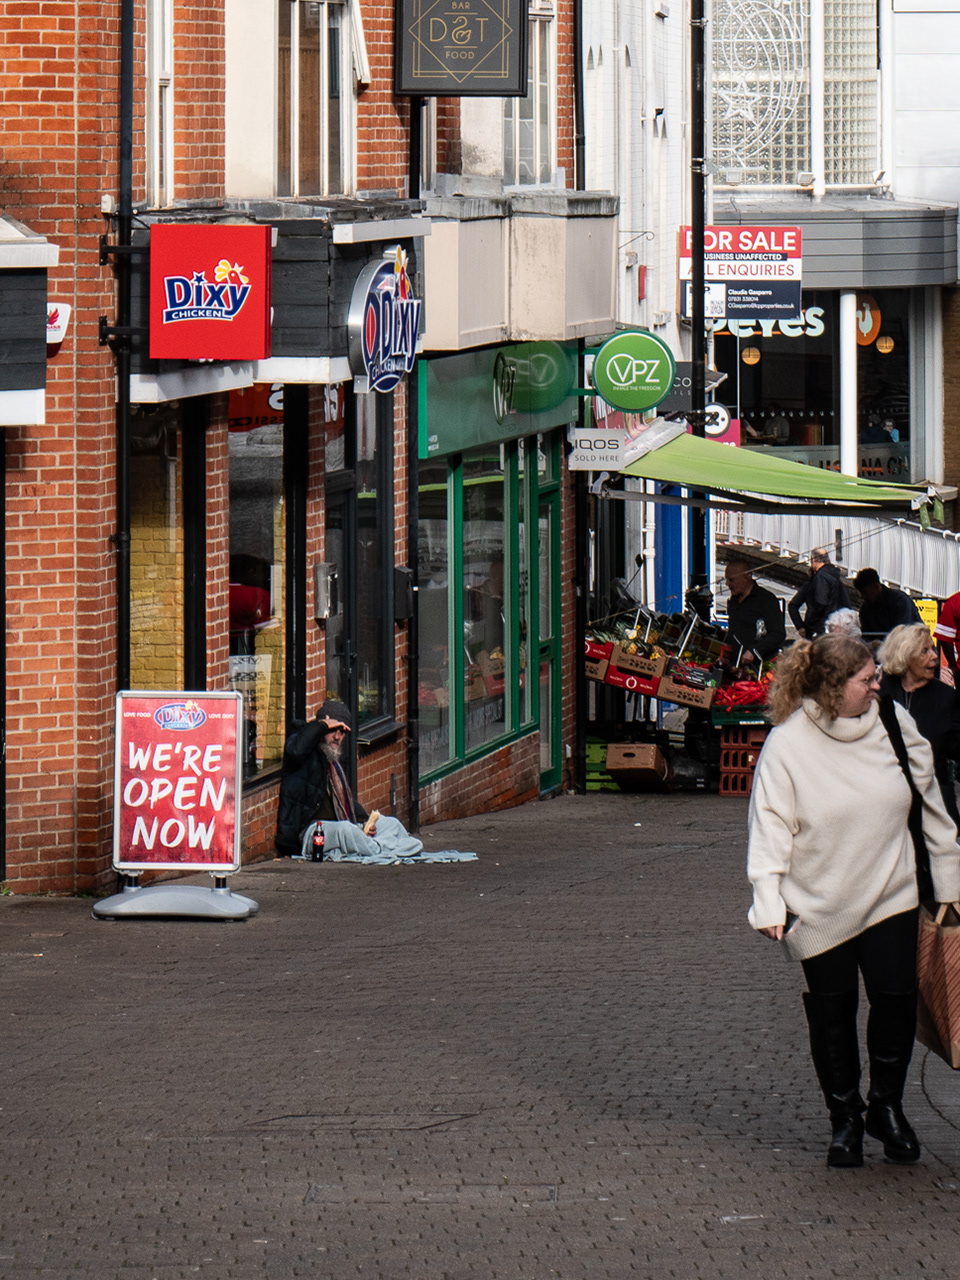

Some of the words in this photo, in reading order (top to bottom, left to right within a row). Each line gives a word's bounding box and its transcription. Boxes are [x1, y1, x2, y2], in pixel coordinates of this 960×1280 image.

[451, 1, 470, 10] BAR
[445, 50, 475, 60] FOOD
[738, 231, 797, 251] SALE
[735, 253, 782, 261] UNAFFECTED
[718, 263, 795, 277] ENQUIRIES
[164, 271, 252, 318] Dixy
[171, 309, 221, 319] CHICKEN
[606, 353, 660, 386] VPZ
[575, 439, 620, 451] IQOS
[129, 742, 222, 776] WE'RE
[123, 777, 227, 811] OPEN
[132, 815, 215, 850] NOW
